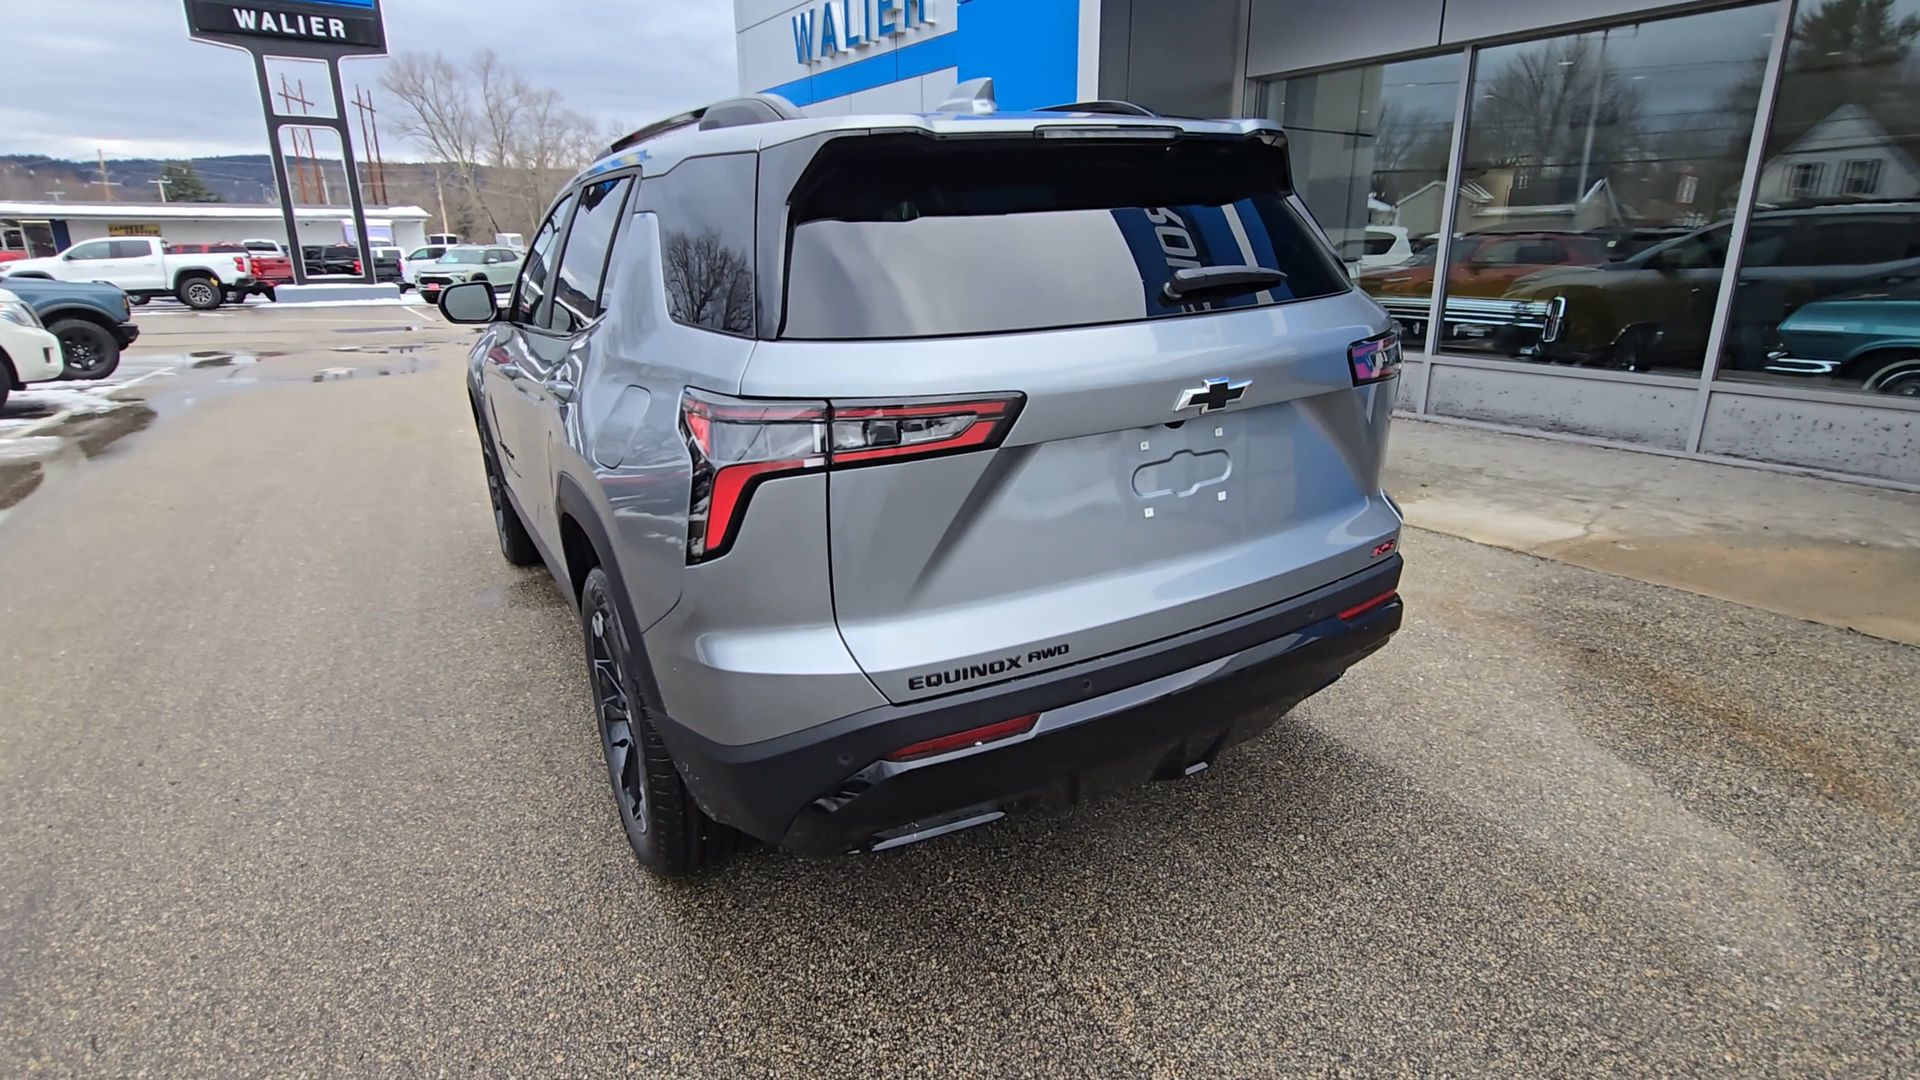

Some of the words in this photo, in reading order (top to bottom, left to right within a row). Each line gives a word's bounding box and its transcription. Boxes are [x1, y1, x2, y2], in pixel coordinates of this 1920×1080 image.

[232, 8, 346, 39] WALIER
[908, 655, 1022, 690] EQUINOX
[1028, 643, 1070, 663] AWD
